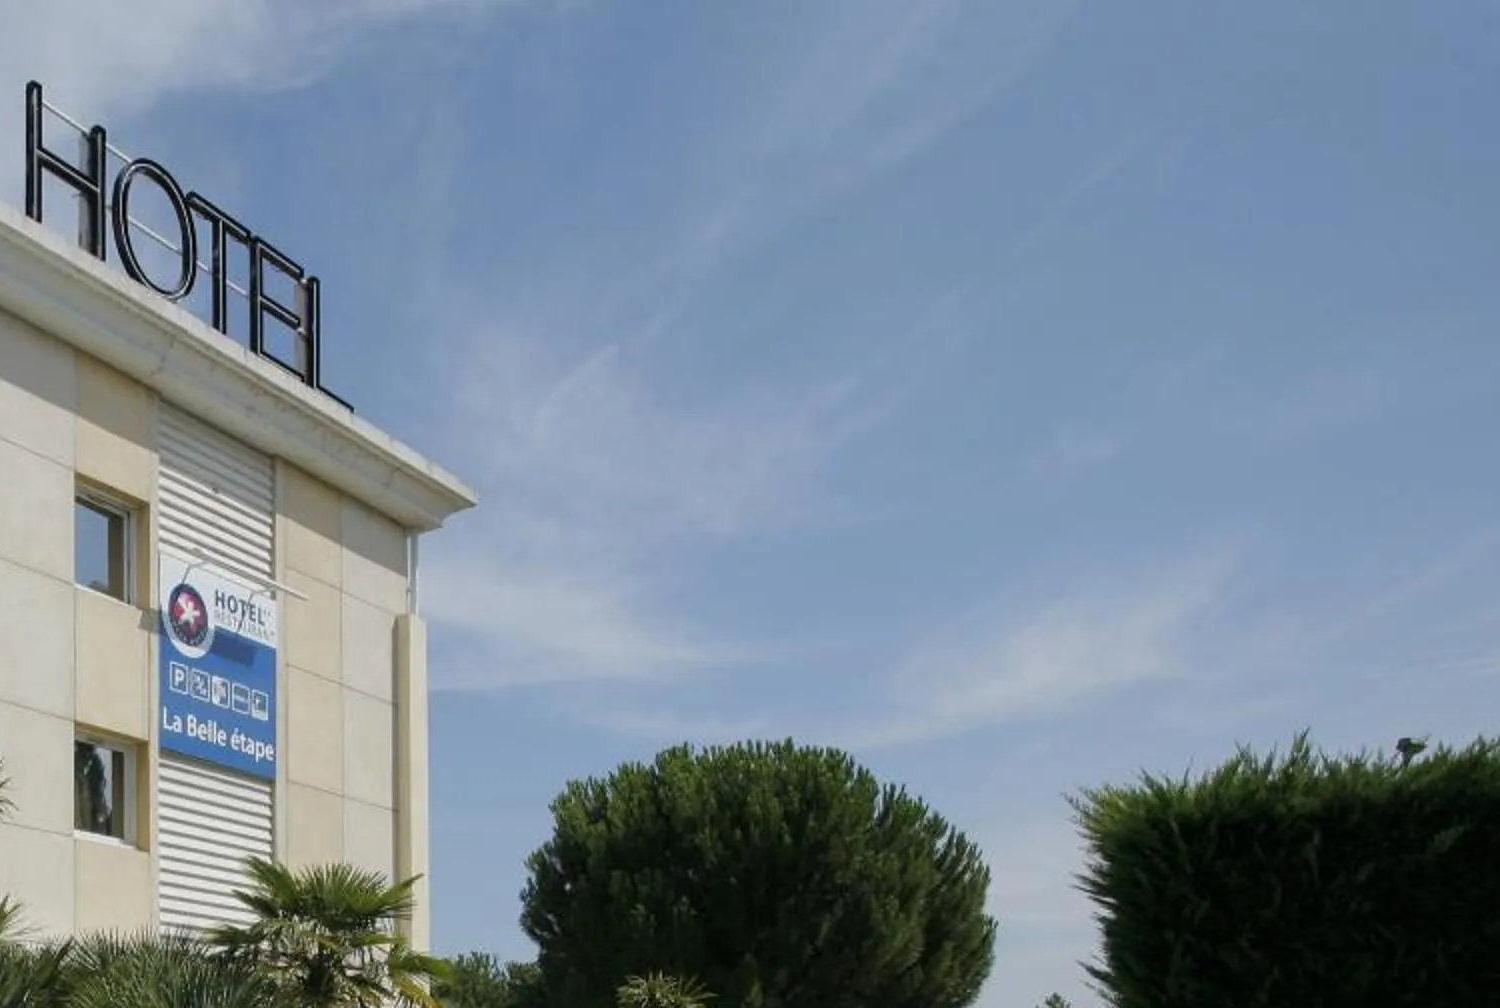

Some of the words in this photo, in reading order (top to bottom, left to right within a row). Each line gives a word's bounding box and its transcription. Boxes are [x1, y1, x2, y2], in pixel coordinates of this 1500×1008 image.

[26, 80, 354, 413] HOTEL
[215, 589, 265, 627] HOTEL
[174, 669, 185, 687] P
[163, 706, 182, 733] La
[188, 715, 226, 746] Belle
[231, 728, 275, 762] étape
